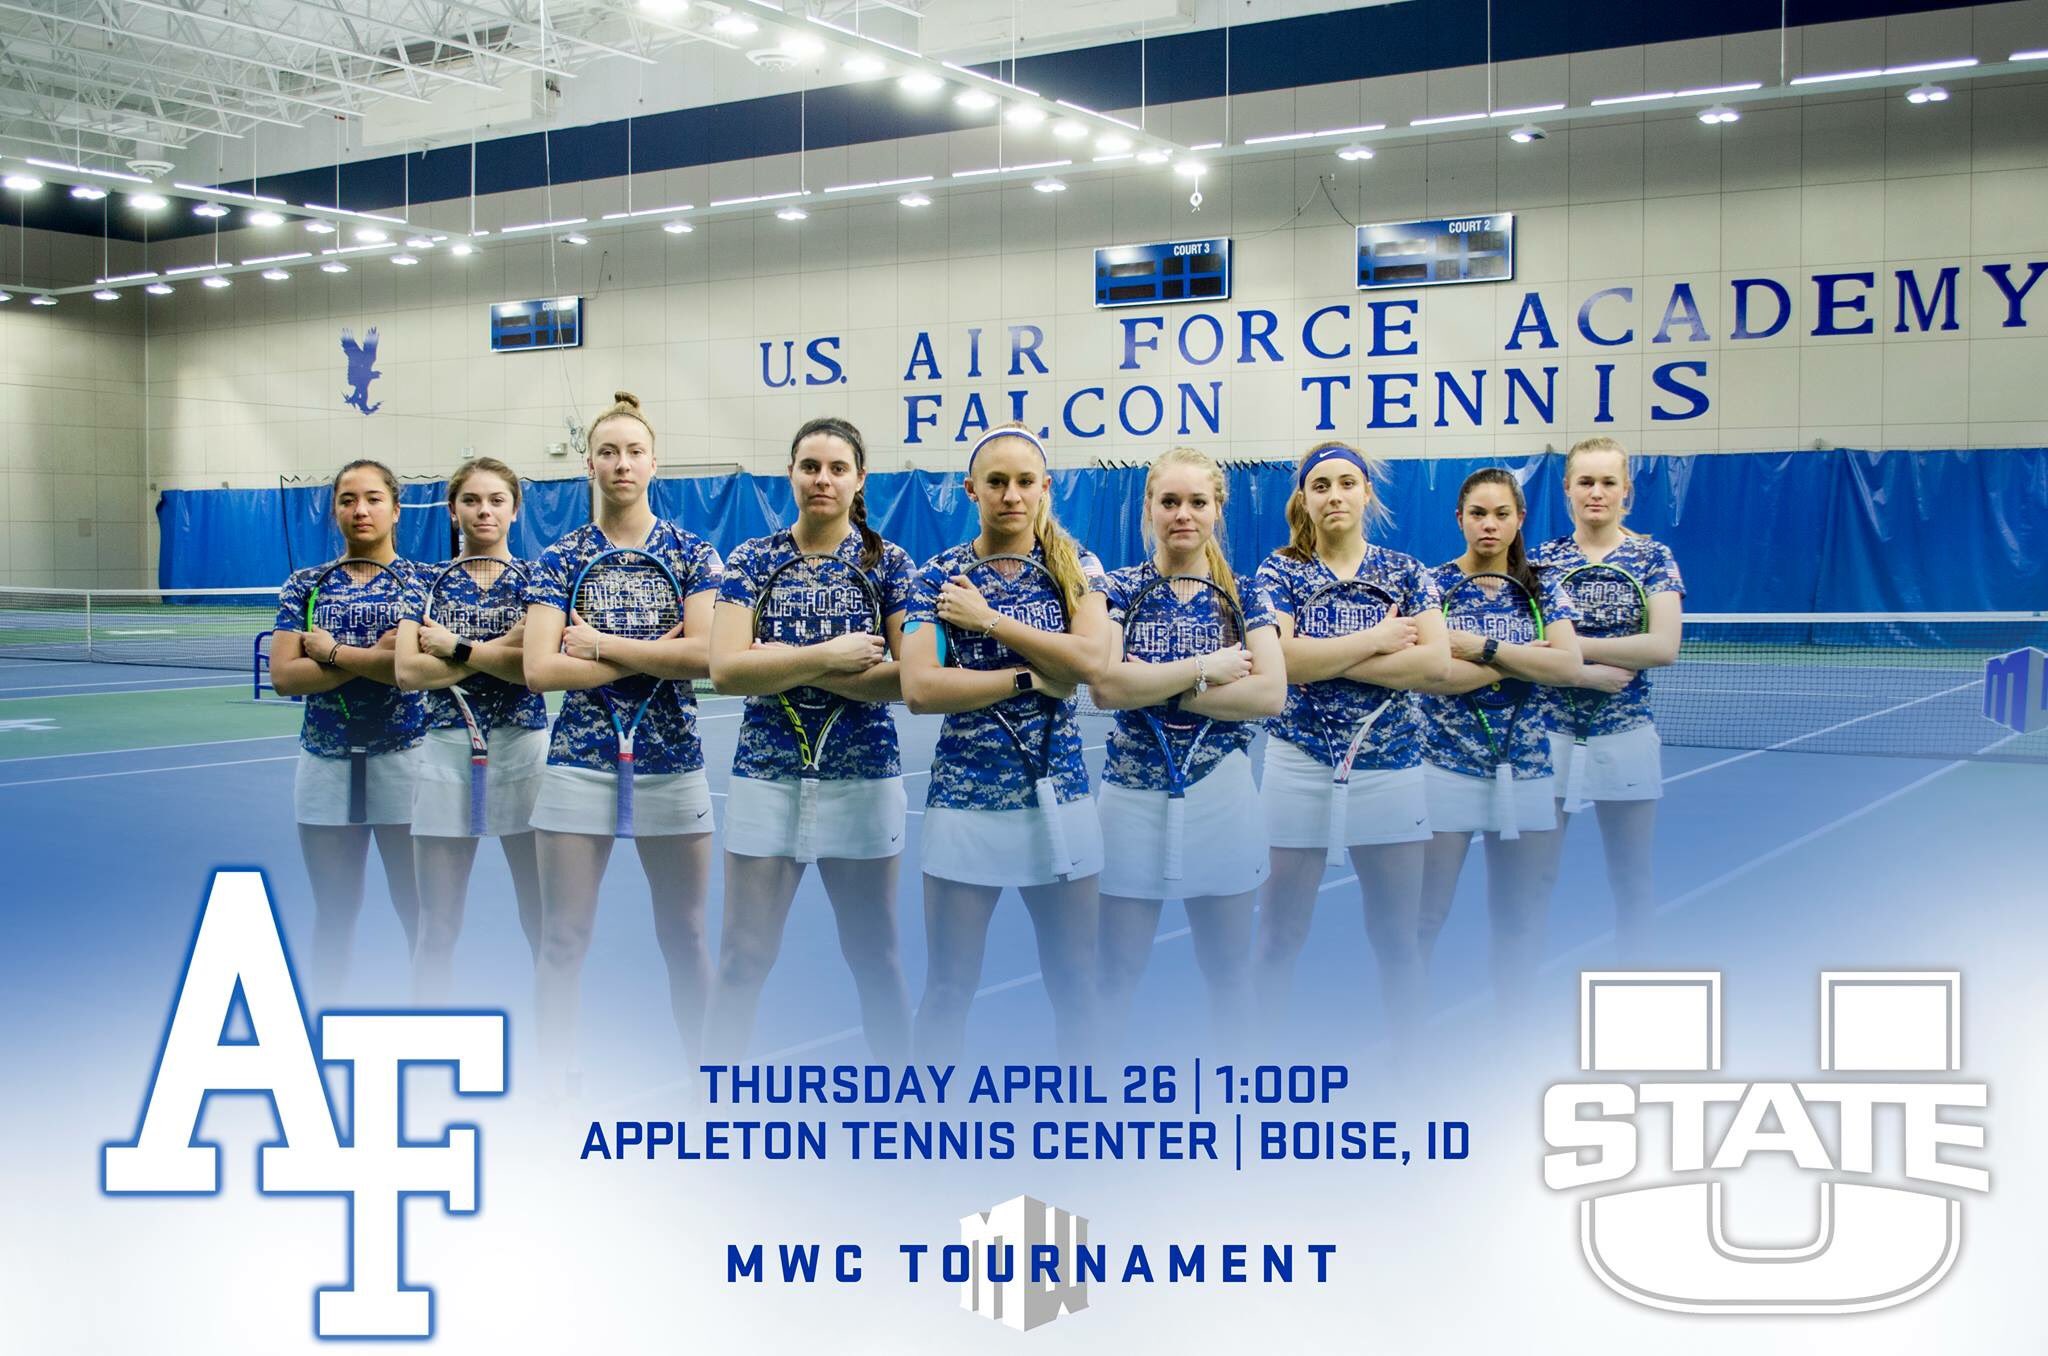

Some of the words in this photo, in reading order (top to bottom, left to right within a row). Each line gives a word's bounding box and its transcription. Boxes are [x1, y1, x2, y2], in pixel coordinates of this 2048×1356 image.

[1449, 220, 1482, 234] COURT
[1484, 219, 1491, 231] 2
[1173, 243, 1203, 257] COURT
[1203, 242, 1211, 254] 3
[759, 336, 849, 389] U.S.
[903, 324, 1050, 382] AIR
[1119, 299, 1419, 371] FORCE
[1504, 261, 2048, 351] ACADEMY
[903, 380, 1224, 444] FALCON
[1301, 360, 1711, 431] TENNIS
[1579, 580, 1643, 605] FORC
[349, 601, 401, 627] FORC
[998, 599, 1064, 632] ORC
[1335, 603, 1390, 634] FOR
[1483, 614, 1540, 643] FORC
[1176, 619, 1226, 652] FOR
